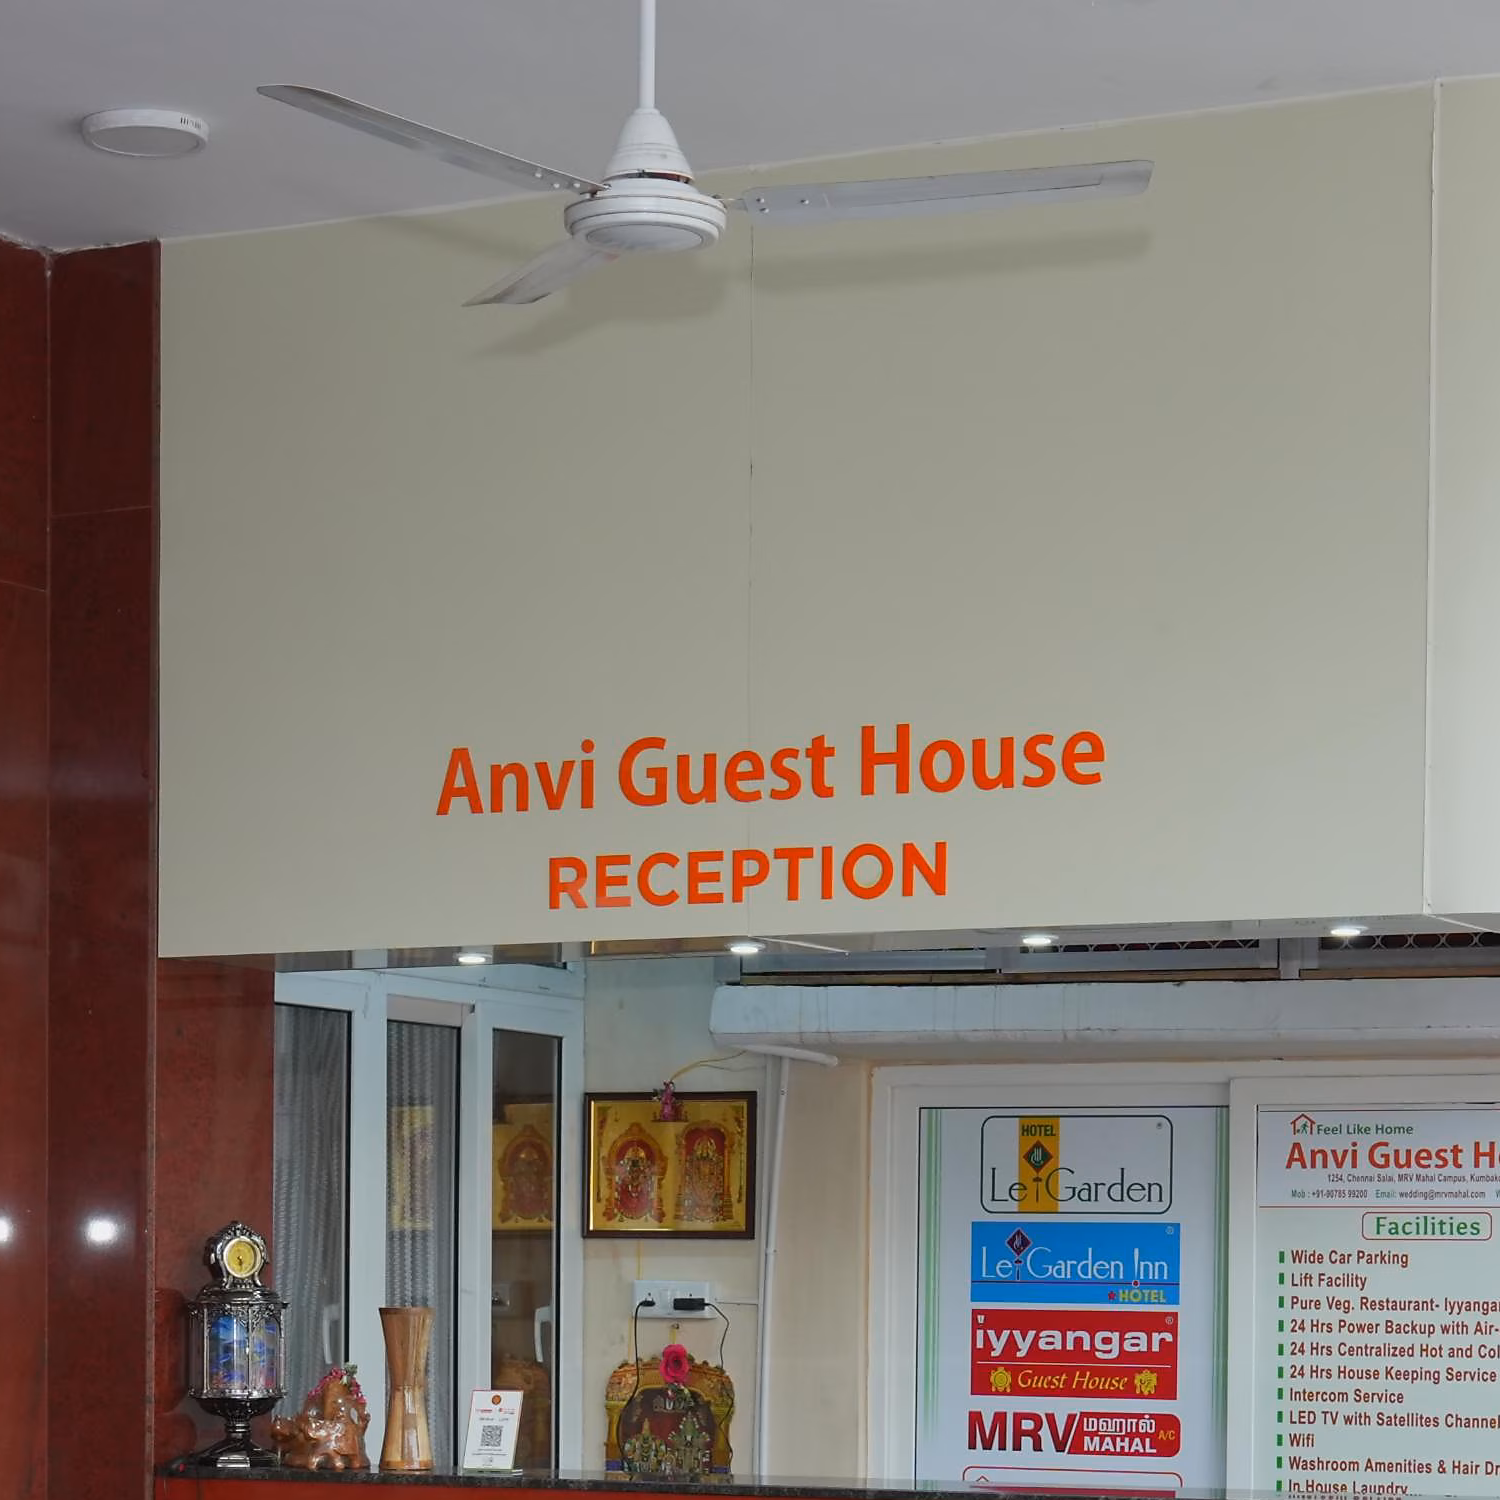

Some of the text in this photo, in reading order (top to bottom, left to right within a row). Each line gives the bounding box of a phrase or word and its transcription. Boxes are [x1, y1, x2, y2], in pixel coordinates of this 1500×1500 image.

[436, 723, 1105, 816] Anvi Guest House
[548, 841, 947, 910] RECEPTION
[1021, 1124, 1056, 1137] HOTEL
[1317, 1123, 1414, 1135] Feel Like Home
[1286, 1141, 1358, 1169] Anvi
[1368, 1141, 1463, 1169] Guest
[990, 1167, 1164, 1202] Le Garden
[1327, 1173, 1345, 1183] 1254,
[1347, 1173, 1375, 1183] Chennai
[1377, 1173, 1396, 1184] Salai,
[1397, 1174, 1414, 1183] MRV
[1415, 1174, 1436, 1183] Mahal
[1437, 1174, 1468, 1185] Campus,
[1291, 1190, 1306, 1199] Mob
[1375, 1189, 1396, 1199] Email:
[1399, 1190, 1485, 1201] wedding@mrvmahal.com
[1375, 1215, 1481, 1236] Facilities
[981, 1246, 1169, 1282] Le Garden Inn
[1291, 1250, 1409, 1268] Wide Car Parking
[1291, 1273, 1367, 1291] Lift Facility
[1118, 1289, 1167, 1303] HOTEL
[1291, 1296, 1321, 1311] Pure
[1326, 1296, 1355, 1314] Veg.
[1360, 1296, 1440, 1312] Restaurant-
[975, 1315, 1174, 1360] iyyangar
[1290, 1319, 1306, 1334] 24
[1310, 1319, 1333, 1334] Hrs
[1338, 1320, 1381, 1335] Power
[1385, 1320, 1436, 1338] Backup
[1440, 1320, 1469, 1336] with
[1290, 1342, 1306, 1356] 24
[1310, 1342, 1333, 1357] Hrs
[1338, 1342, 1415, 1358] Centralized
[1419, 1343, 1443, 1358] Hot
[1448, 1343, 1473, 1359] and
[1018, 1370, 1129, 1391] Guest House
[1290, 1364, 1497, 1384] 24 Hrs House Keeping Service
[1290, 1388, 1404, 1404] Intercom Service
[1083, 1414, 1156, 1436] மஹால்
[1289, 1410, 1500, 1429] LED TV with Satellites Channel
[967, 1410, 1078, 1453] MRV
[1158, 1430, 1177, 1441] A/C
[1289, 1433, 1315, 1448] Wifi
[1083, 1436, 1157, 1454] MAHAL
[1289, 1456, 1360, 1472] Washroom
[1364, 1457, 1432, 1474] Amenities
[1437, 1459, 1447, 1474] &
[1451, 1460, 1480, 1475] Hair
